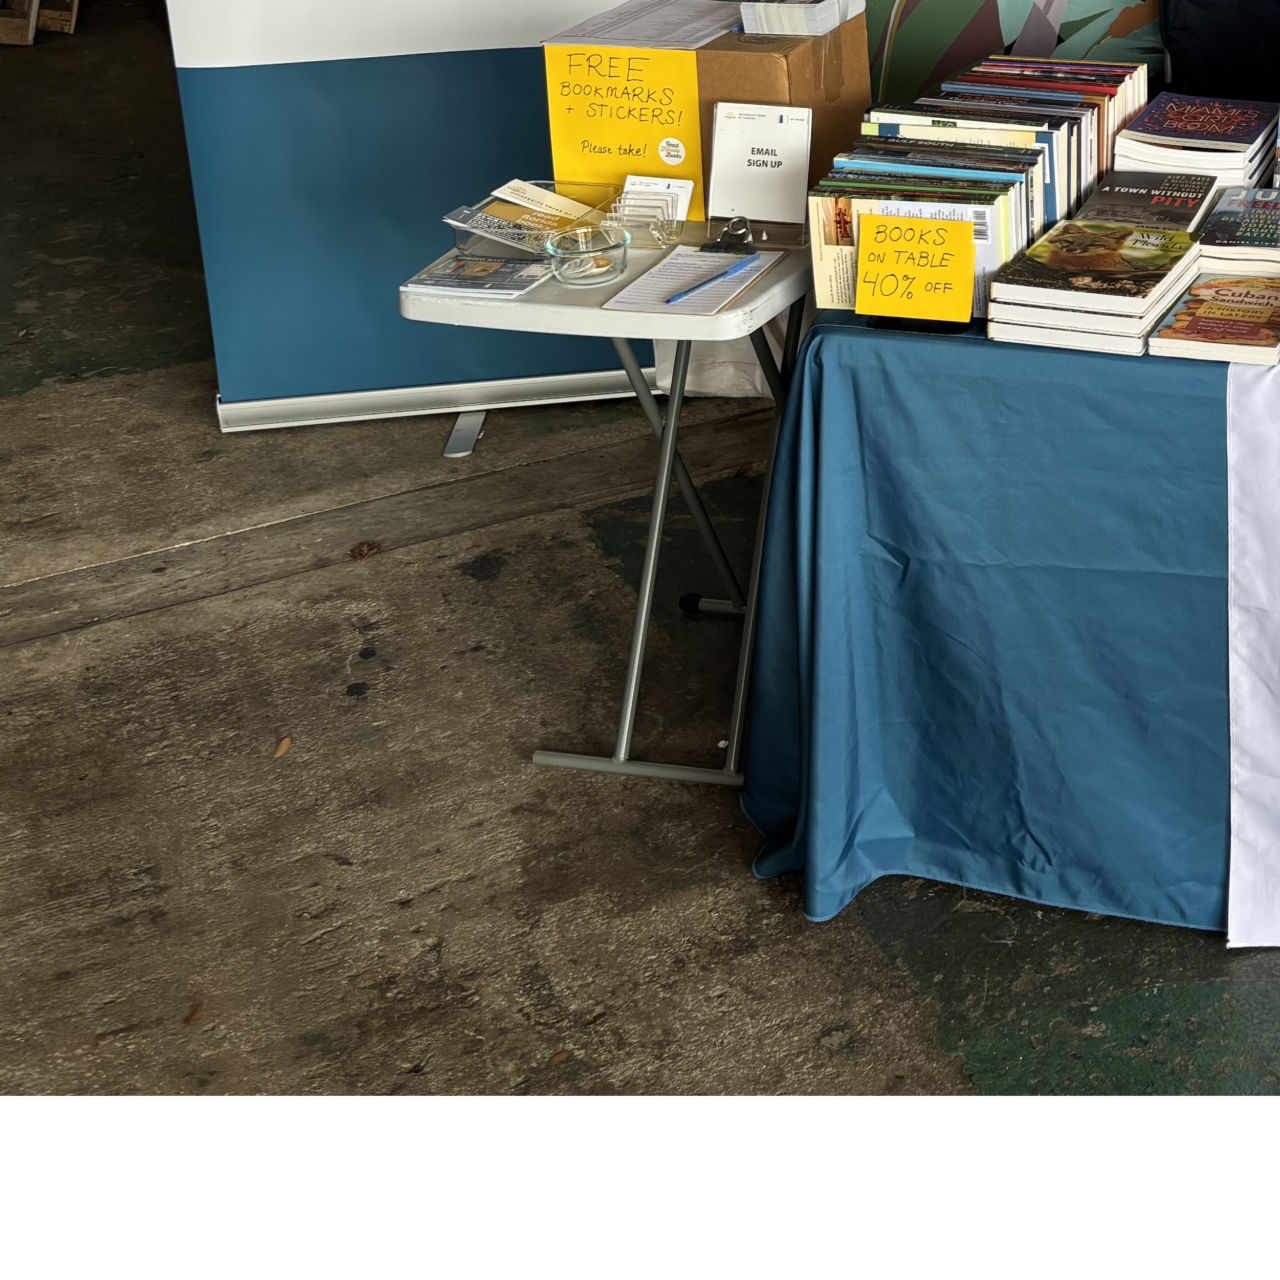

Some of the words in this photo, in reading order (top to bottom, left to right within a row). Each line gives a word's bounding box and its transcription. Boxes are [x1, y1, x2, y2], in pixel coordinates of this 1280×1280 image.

[566, 53, 650, 82] FREE
[559, 81, 674, 106] BOOKMARKS
[586, 102, 683, 127] STICKERS!
[1164, 102, 1260, 118] MIAMI'S
[1163, 121, 1236, 134] BOOM
[580, 139, 613, 155] Please
[618, 143, 648, 158] take!
[887, 138, 922, 146] GULF
[922, 139, 954, 148] SOUTH
[750, 146, 779, 157] EMAIL
[746, 158, 769, 168] SIGN
[770, 160, 783, 169] UP
[1114, 186, 1148, 195] TOWN
[1151, 189, 1205, 199] WITHOUT
[1150, 195, 1200, 209] PITY
[520, 214, 559, 227] florida
[532, 211, 561, 221] read
[874, 223, 948, 246] BOOKS
[1139, 232, 1176, 243] Wild
[1235, 231, 1280, 239] BATTLE
[1132, 239, 1183, 250] Florida
[867, 252, 886, 265] ON
[893, 250, 955, 268] TABLE
[863, 271, 917, 300] 40%
[924, 281, 953, 295] OFF
[1214, 288, 1280, 301] Cuban
[1209, 296, 1275, 308] Sandwich
[1215, 307, 1266, 315] HISTORY
[1219, 312, 1263, 320] LAYERS
